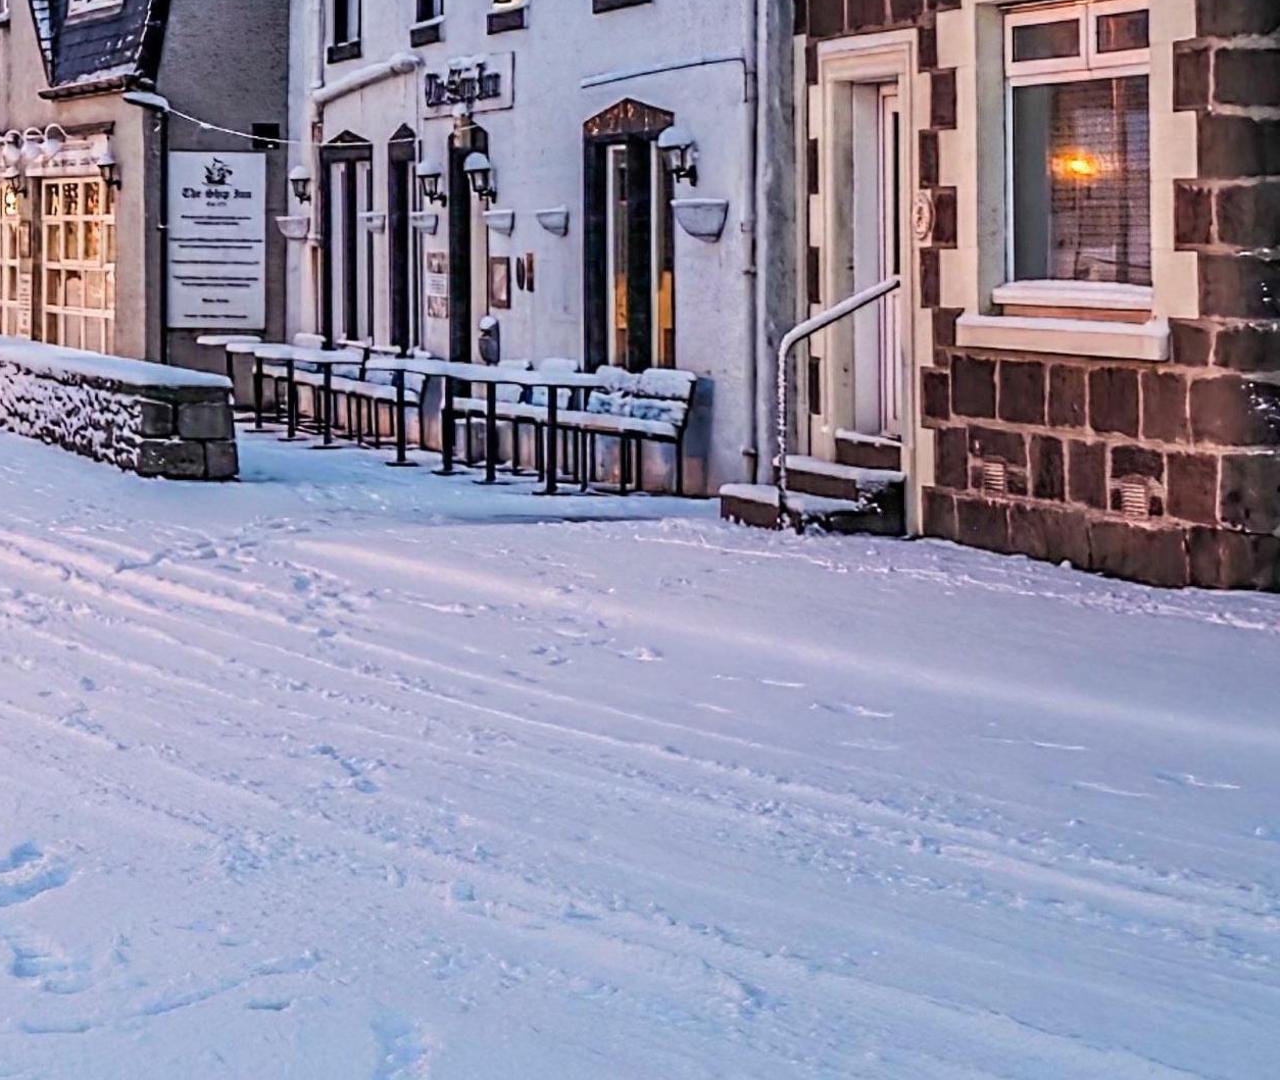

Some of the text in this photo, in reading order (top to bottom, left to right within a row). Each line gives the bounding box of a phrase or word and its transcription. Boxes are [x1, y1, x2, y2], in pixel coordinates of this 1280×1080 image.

[181, 187, 252, 200] The Ship Inn
